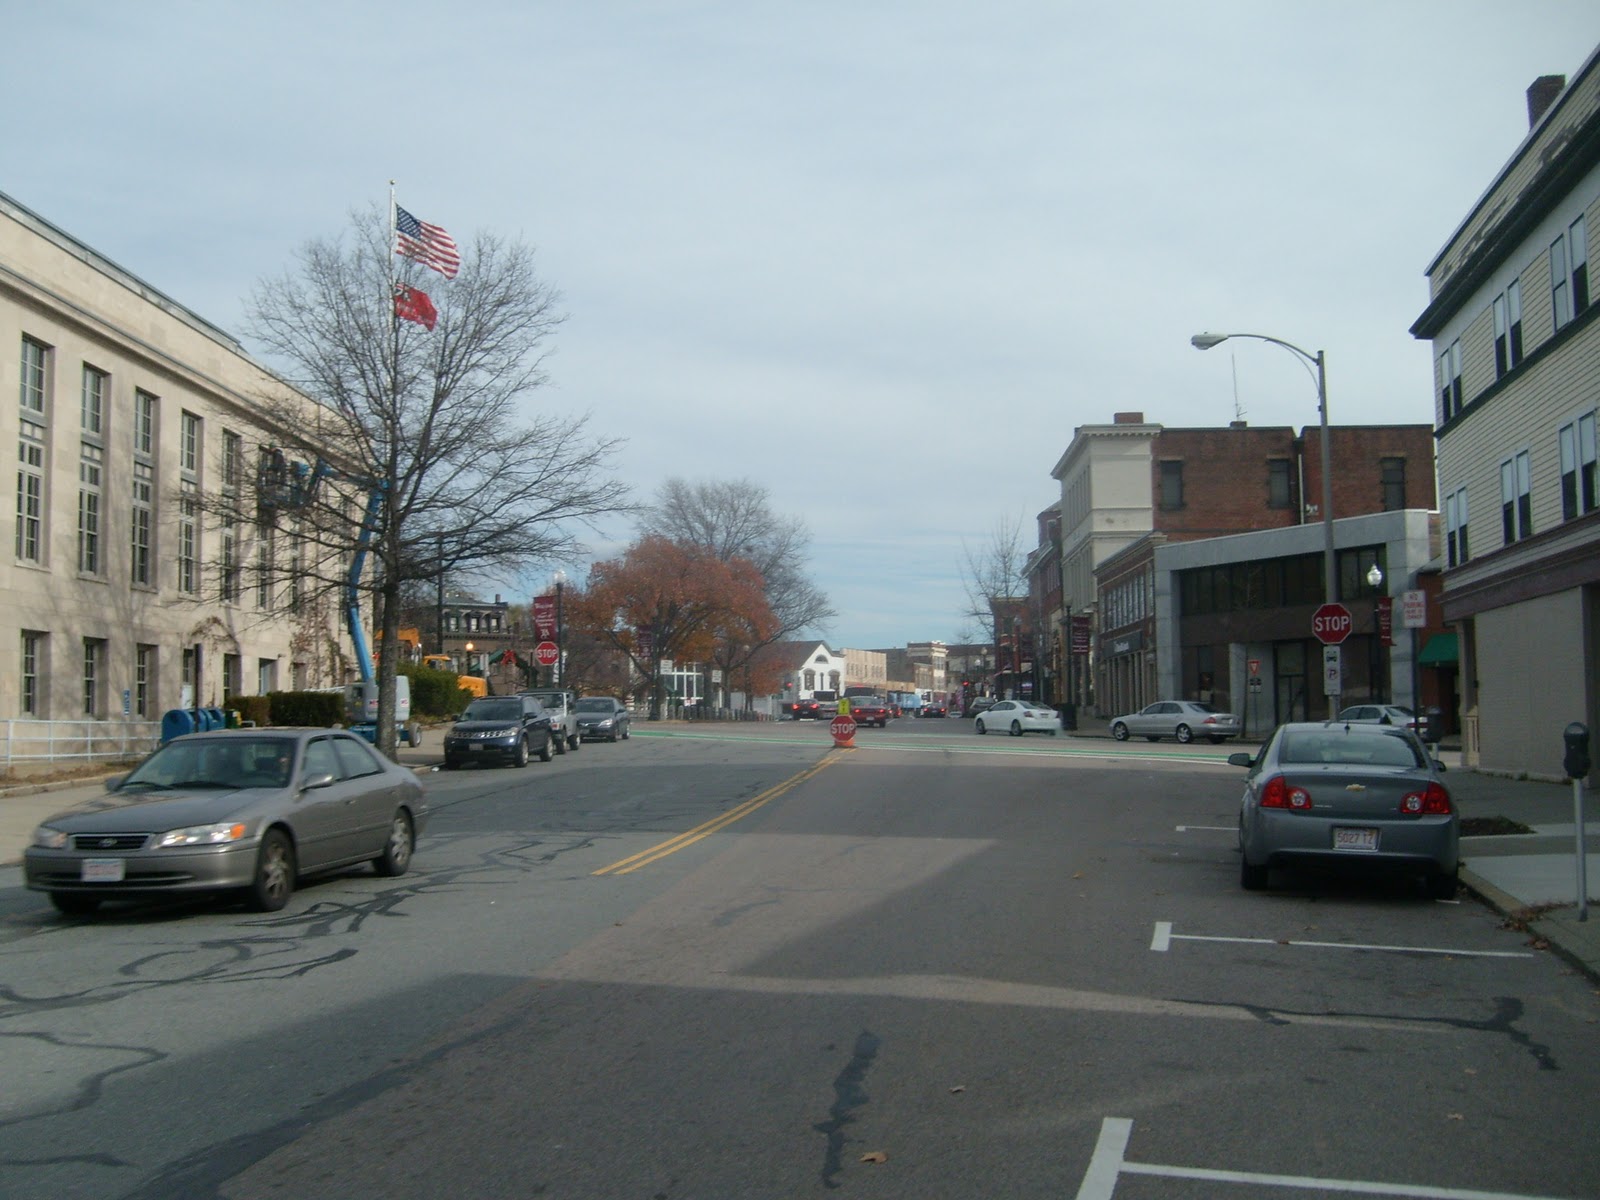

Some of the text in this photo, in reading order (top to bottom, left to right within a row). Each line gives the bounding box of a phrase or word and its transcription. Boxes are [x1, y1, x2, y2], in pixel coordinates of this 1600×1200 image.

[1315, 616, 1349, 631] STOP
[537, 649, 557, 658] STOP
[831, 723, 855, 734] STOP
